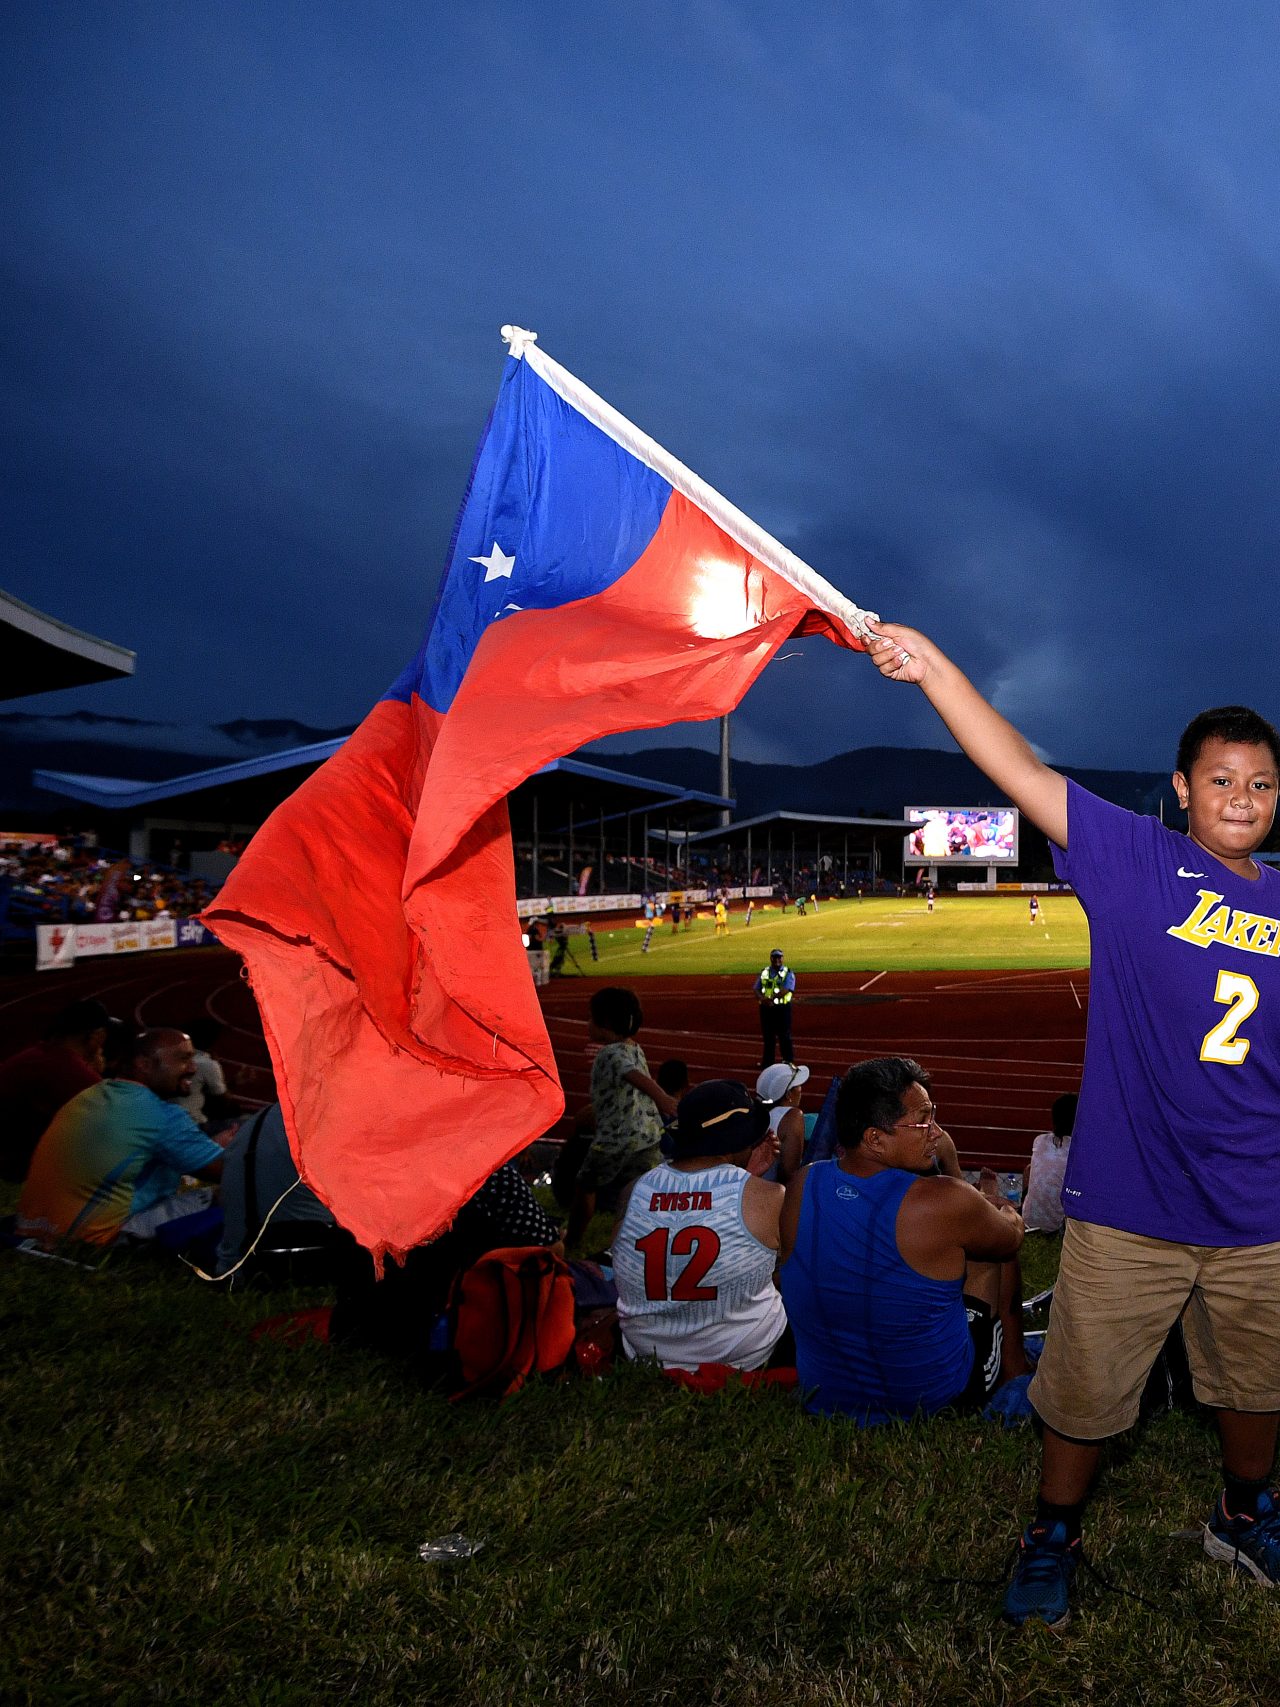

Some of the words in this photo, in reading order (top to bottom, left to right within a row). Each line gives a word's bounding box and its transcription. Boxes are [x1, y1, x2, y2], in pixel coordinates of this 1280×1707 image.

[1199, 969, 1260, 1065] 2
[649, 1191, 712, 1212] EVISTA
[635, 1225, 721, 1302] 12
